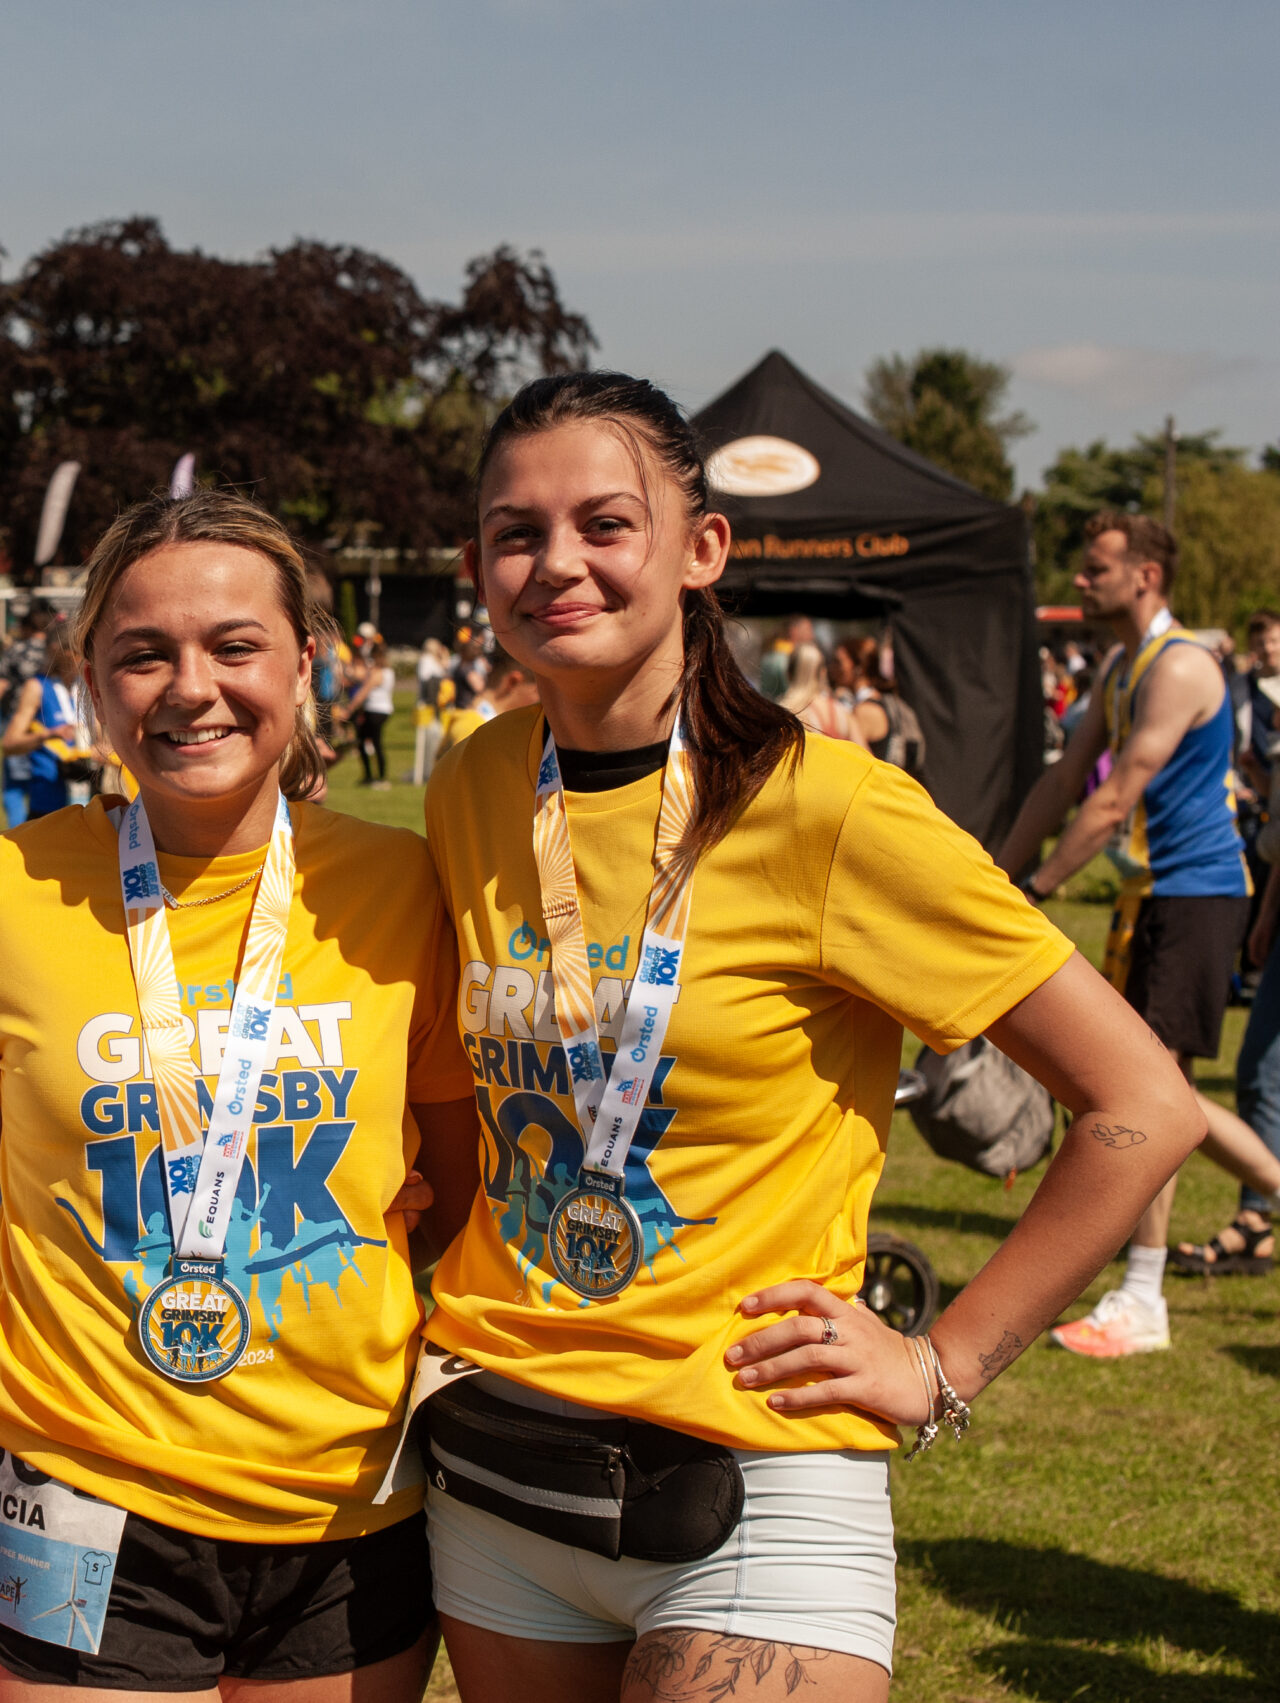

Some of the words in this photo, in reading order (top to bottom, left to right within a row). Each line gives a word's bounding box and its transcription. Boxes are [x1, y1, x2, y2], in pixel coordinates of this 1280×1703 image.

[763, 533, 854, 559] Runners
[855, 532, 910, 557] Club
[123, 865, 144, 903] 10K
[138, 863, 151, 898] GRIMSBY
[145, 861, 160, 896] GREAT
[508, 921, 630, 971] Øred
[639, 944, 656, 983] GREAT
[648, 946, 665, 985] GRIMSBY
[656, 948, 680, 987] 10K
[176, 972, 294, 1006] rstd
[460, 960, 683, 1052] GREA
[232, 1003, 245, 1038] GREAT
[241, 1005, 255, 1039] GRIMSBY
[249, 1006, 272, 1041] 10K
[463, 1032, 678, 1105] GRIMY
[567, 1042, 588, 1085] 10K
[79, 1068, 360, 1136] GRSBY
[601, 1116, 623, 1168] EQUANS
[85, 1121, 364, 1263] 10K
[168, 1156, 190, 1197] 10K
[206, 1171, 225, 1224] EQUANS
[567, 1203, 623, 1232] GREAT
[567, 1219, 622, 1241] GRIMSBY
[565, 1232, 619, 1269] 10K
[160, 1291, 228, 1312] GREAT
[160, 1308, 228, 1323] GRIMSBY
[160, 1321, 225, 1351] 10K
[237, 1348, 275, 1367] 2024
[0, 1545, 17, 1559] FREE
[17, 1552, 51, 1570] RUNNER
[92, 1562, 99, 1573] S
